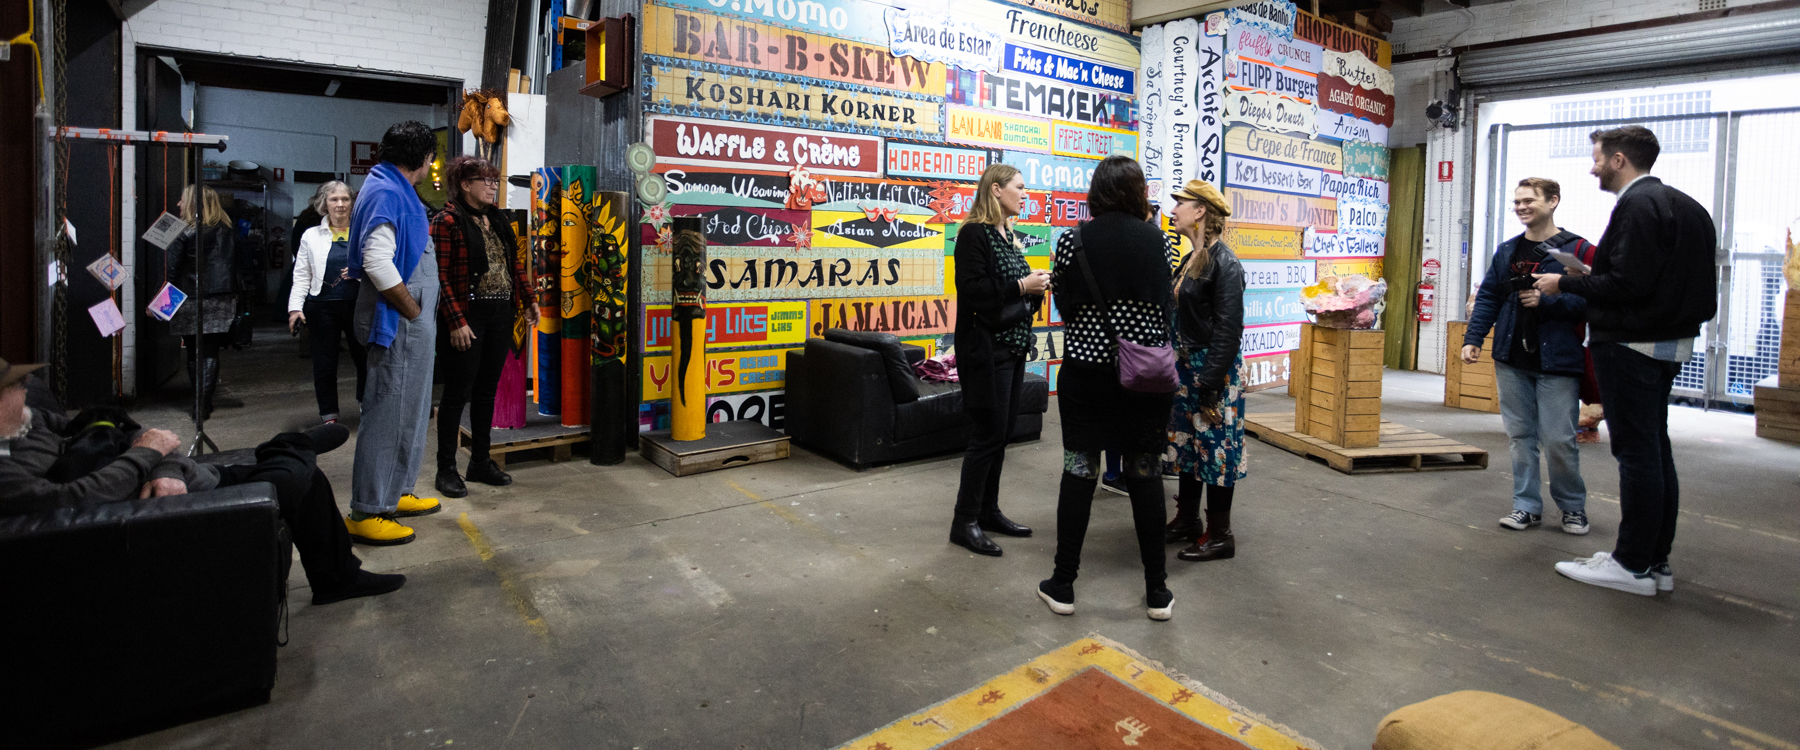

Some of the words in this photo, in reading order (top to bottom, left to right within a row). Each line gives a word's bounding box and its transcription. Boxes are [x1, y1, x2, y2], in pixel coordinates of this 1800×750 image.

[1006, 9, 1099, 52] Frencheese
[1268, 4, 1289, 27] Banho
[673, 13, 930, 89] BAR-B-SKEW
[940, 27, 955, 50] de
[959, 32, 992, 57] Estar
[1238, 30, 1273, 57] fluffy
[1277, 43, 1311, 64] CRUNCH
[1013, 47, 1043, 74] Fries
[1043, 54, 1055, 76] &
[1055, 57, 1089, 83] Mac'n
[1091, 65, 1124, 90] Cheese
[1168, 35, 1190, 116] Courtney's
[1241, 61, 1272, 89] FLIPP
[1336, 57, 1378, 87] Butter
[685, 75, 811, 112] KOSHARI
[821, 93, 917, 125] KORNER
[983, 74, 1109, 125] TEMASEK
[1200, 45, 1221, 127] Archie
[1140, 88, 1162, 138] Crêpe
[1239, 95, 1273, 123] Diego's
[1276, 102, 1305, 127] Donuts
[1328, 87, 1354, 107] AGAPÉ
[1355, 95, 1386, 117] ORGANIC
[951, 114, 974, 136] LAN
[1004, 122, 1041, 135] SHANGHAI
[1004, 133, 1048, 146] DUMPLINGS
[676, 123, 766, 160] WAFFLE
[773, 139, 790, 163] &
[1058, 128, 1083, 152] PAPER
[1086, 132, 1113, 155] STREET
[1246, 128, 1282, 158] Crepe
[1284, 138, 1298, 159] de
[1300, 140, 1337, 166] France
[888, 148, 953, 175] KOREAN
[1025, 157, 1094, 189] Temas
[1172, 122, 1190, 193] Brasseri
[663, 169, 727, 195] Samoan
[731, 175, 791, 204] Weaving
[825, 177, 871, 208] Netta's
[876, 181, 902, 209] Gift
[1297, 170, 1314, 190] Bar
[1322, 173, 1380, 199] PappaRich
[1231, 191, 1289, 222] DIEGO'S
[1349, 206, 1377, 228] Palco
[745, 211, 792, 245] Chips
[823, 217, 875, 240] Asian
[881, 216, 938, 238] Noodles
[1313, 234, 1345, 254] Chef's
[1345, 236, 1379, 256] Gallery
[706, 258, 901, 290] SAMARAS
[1244, 272, 1280, 286] orean
[1286, 265, 1307, 286] BBQ
[814, 299, 950, 336] JAMAICAN
[1240, 330, 1285, 352] OKKAIDO
[1245, 360, 1278, 387] AR:
